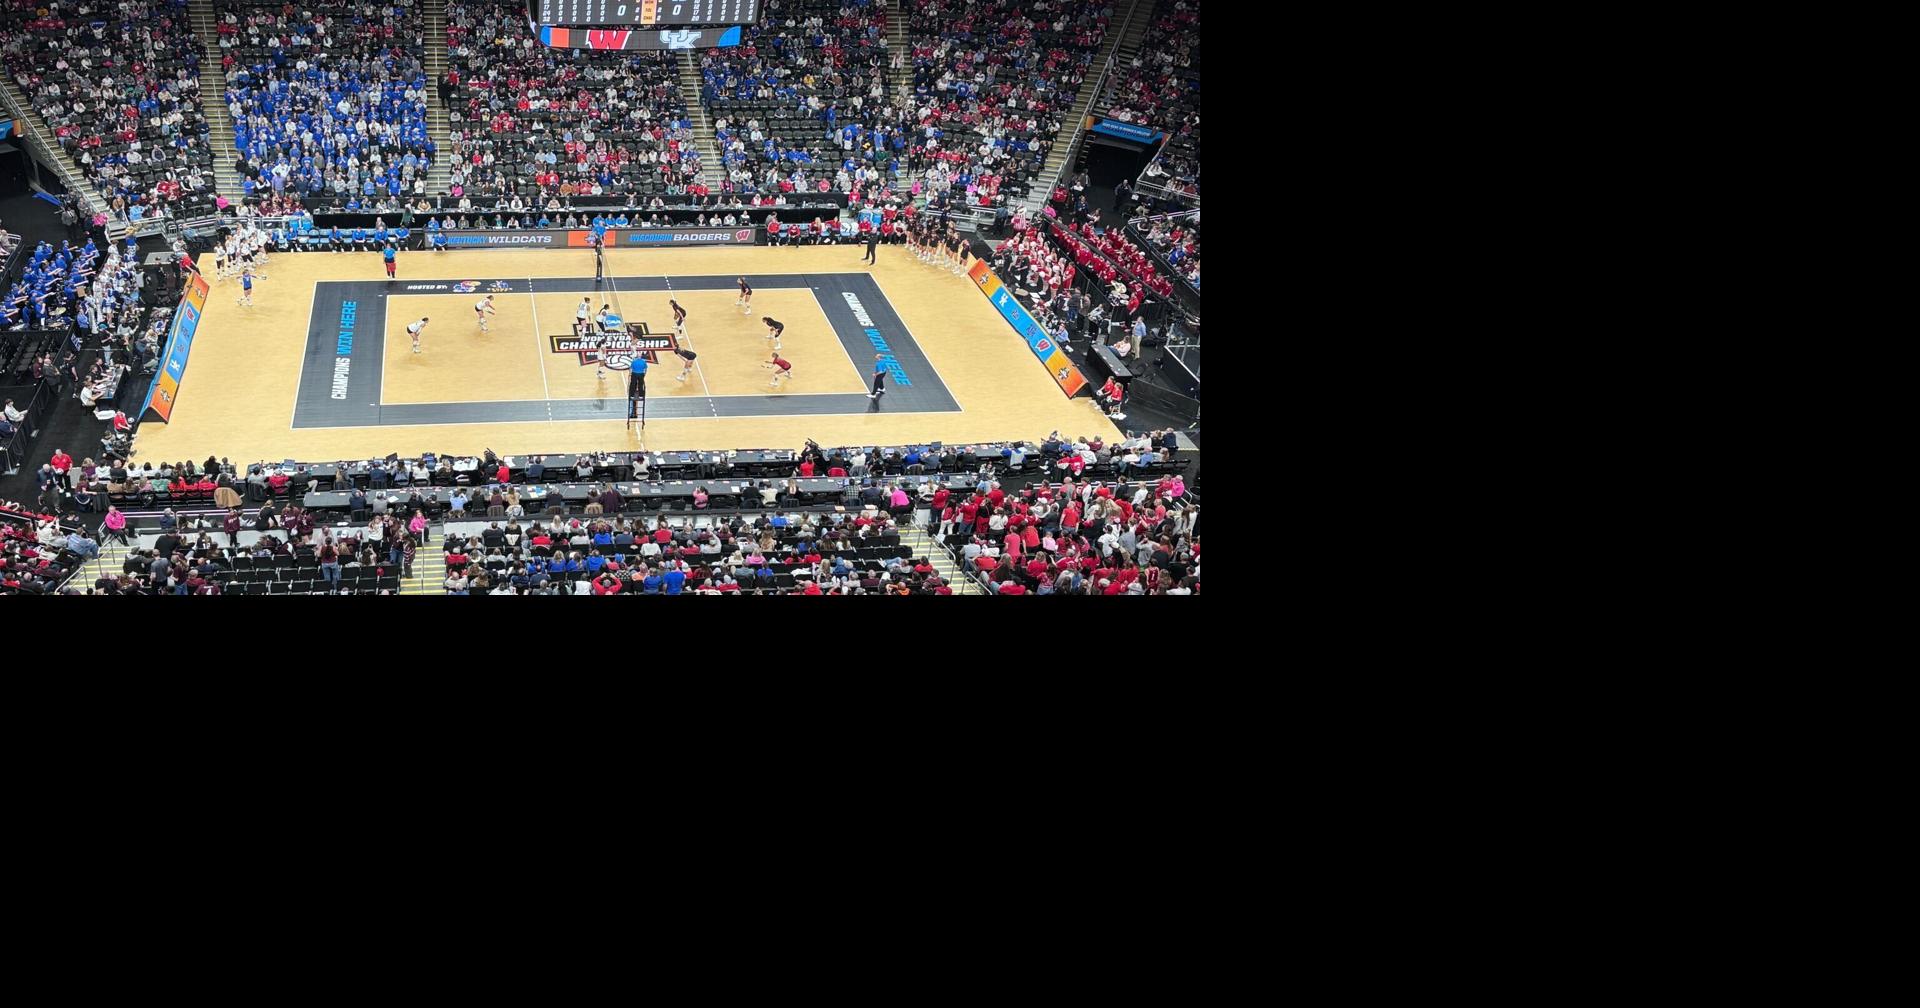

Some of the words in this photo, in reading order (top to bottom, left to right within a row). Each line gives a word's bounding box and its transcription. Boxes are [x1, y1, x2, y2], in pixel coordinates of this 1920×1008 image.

[617, 5, 626, 16] 0
[672, 5, 681, 15] 0
[586, 30, 632, 50] W
[488, 235, 552, 244] WILDCATS
[630, 234, 672, 242] WISCONSIN
[673, 233, 731, 242] BADGERS
[340, 300, 356, 328] HERE
[842, 292, 875, 327] CHAMPIONS
[864, 328, 890, 352] WIN
[336, 331, 353, 355] WIN
[331, 357, 350, 400] CHAMPIONS
